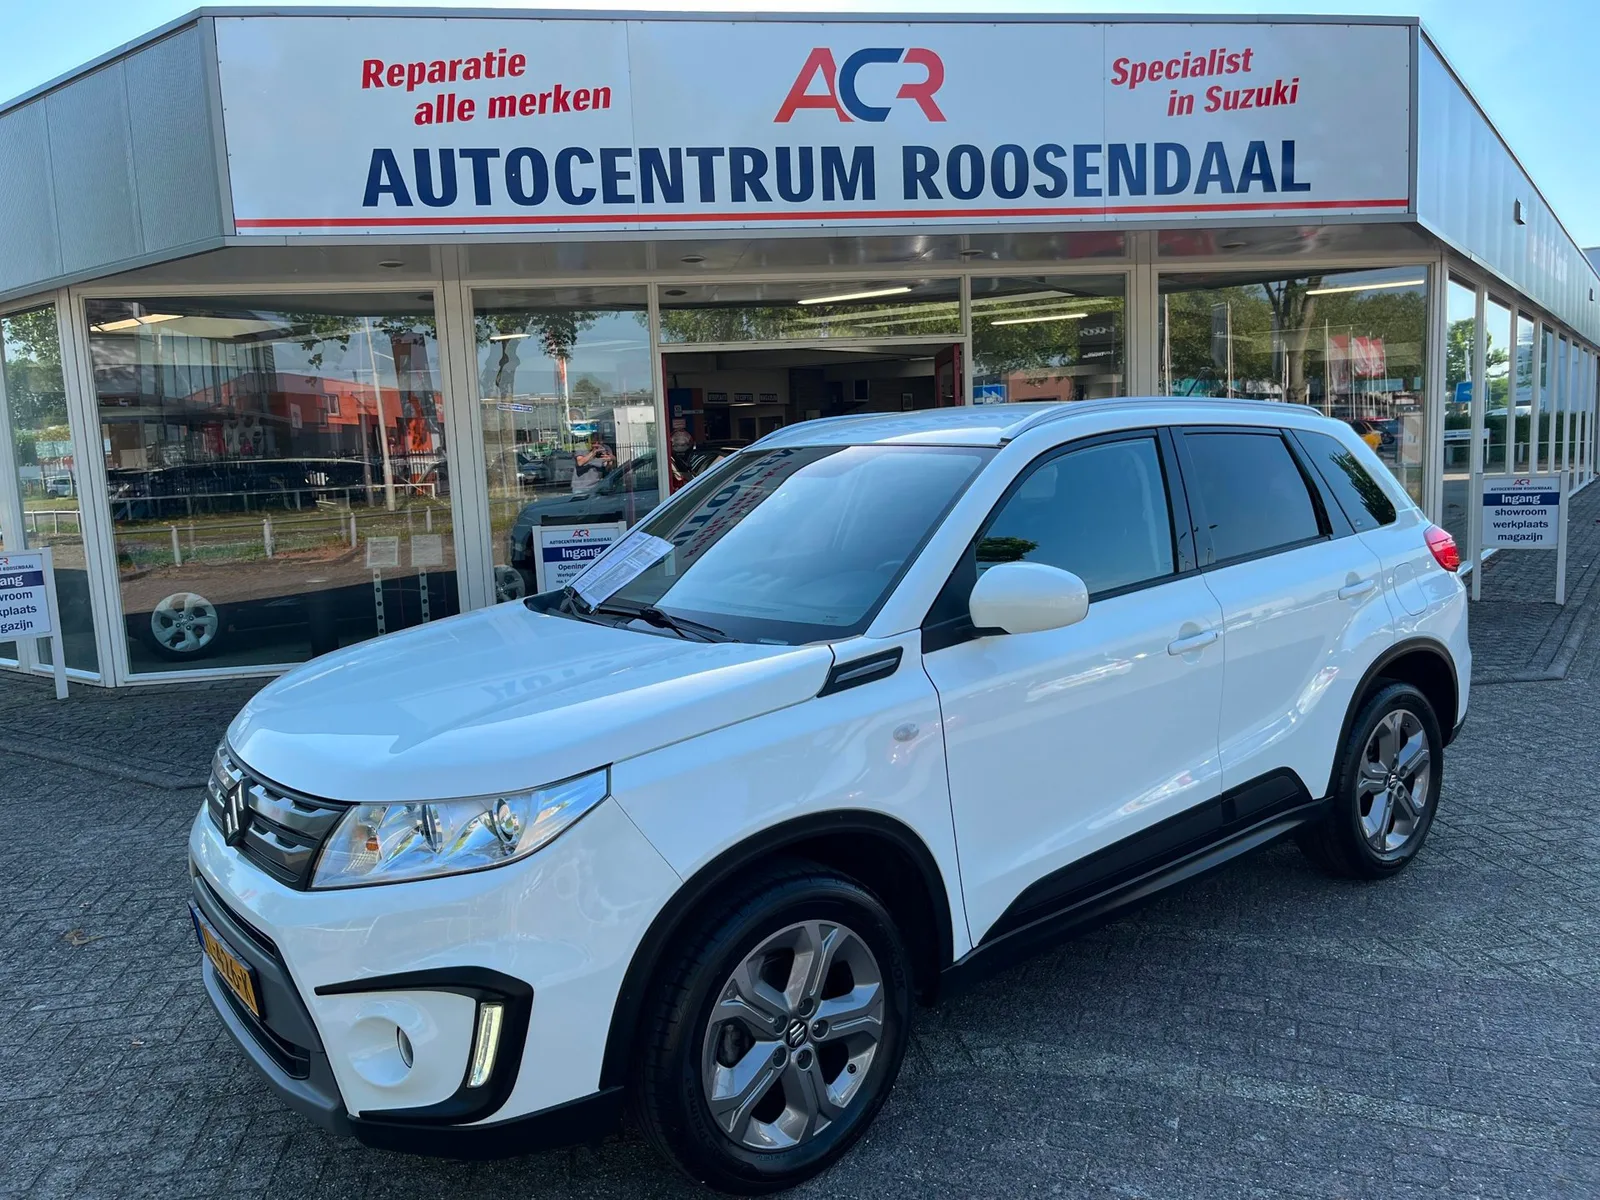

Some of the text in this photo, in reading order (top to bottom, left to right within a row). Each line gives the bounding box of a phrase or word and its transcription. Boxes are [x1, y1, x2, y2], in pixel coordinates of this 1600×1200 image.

[361, 48, 526, 91] Reparatie
[1110, 47, 1253, 89] Specialist
[774, 48, 947, 123] ACR
[1167, 77, 1299, 117] in Suzuki
[413, 85, 612, 125] alle merken
[362, 140, 1311, 208] AUTOCENTRUM ROOSENDAAL
[1502, 494, 1541, 504] Ingang
[1493, 520, 1549, 529] werkplaats
[1495, 508, 1547, 516] showroom
[572, 529, 589, 537] ACR
[1498, 532, 1543, 542] magazijn
[562, 548, 601, 559] Ingang
